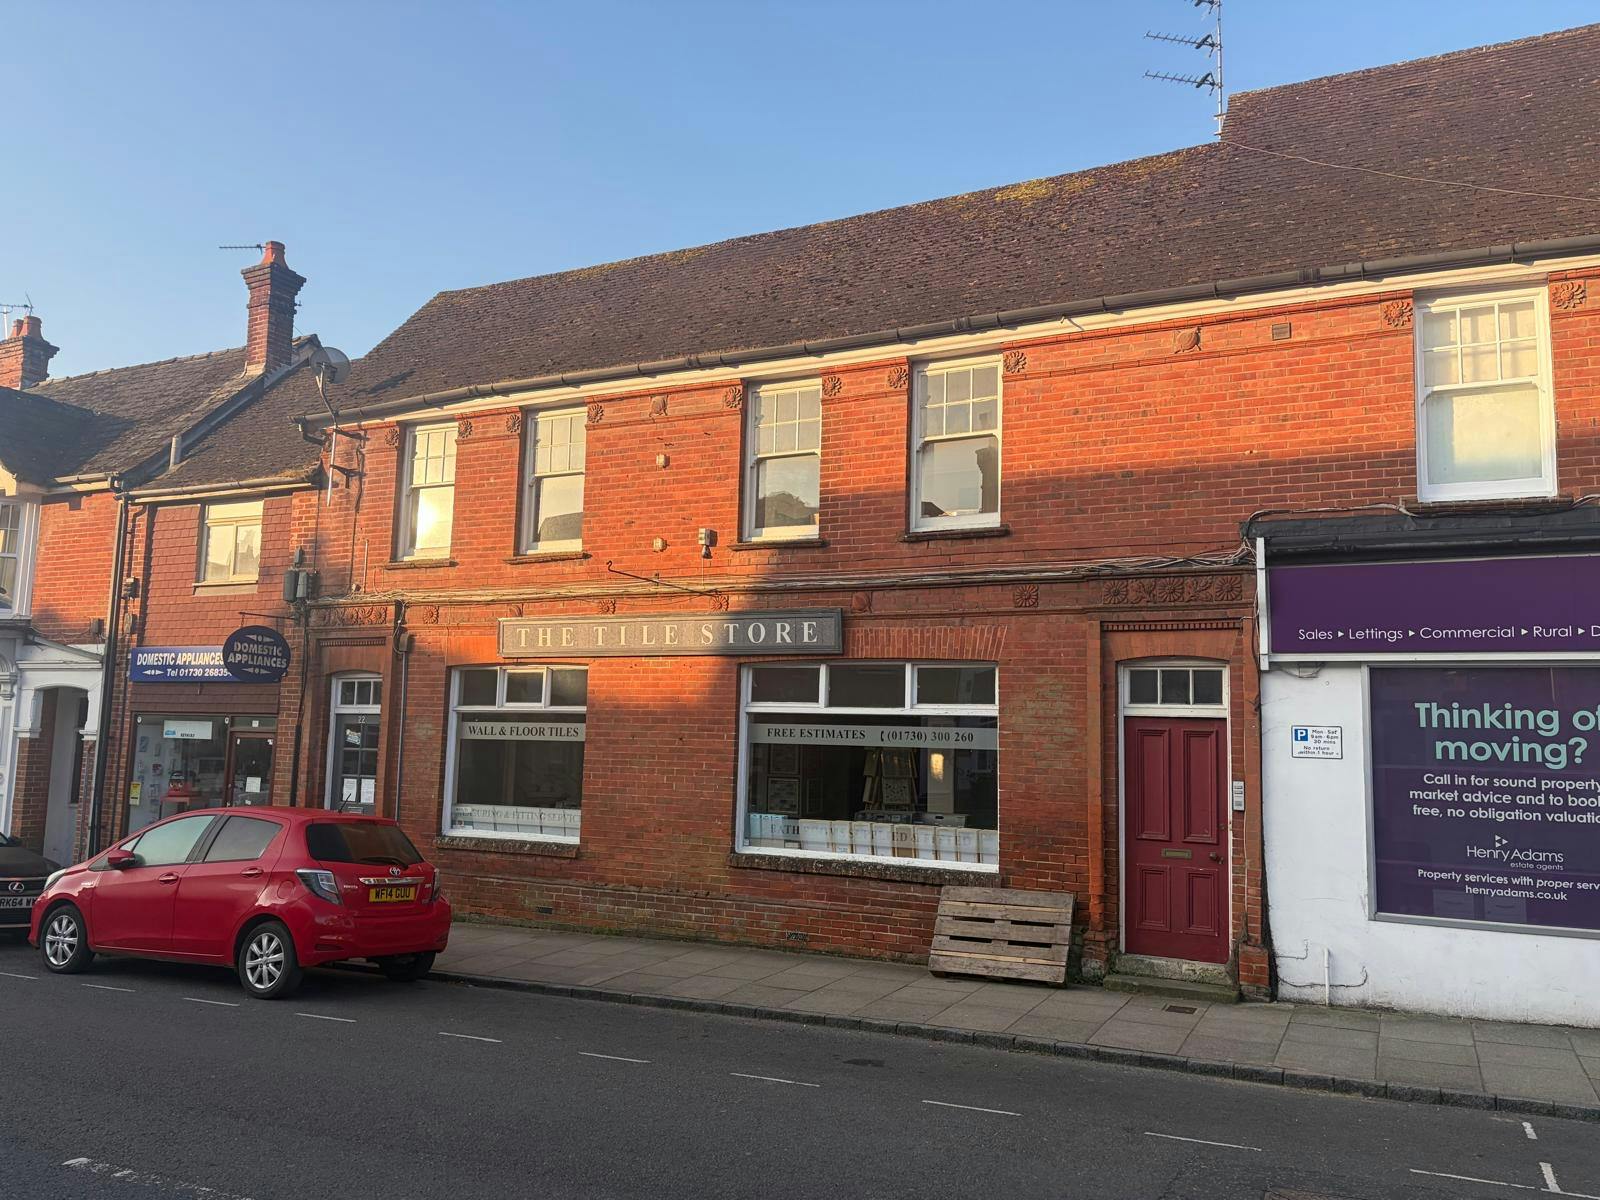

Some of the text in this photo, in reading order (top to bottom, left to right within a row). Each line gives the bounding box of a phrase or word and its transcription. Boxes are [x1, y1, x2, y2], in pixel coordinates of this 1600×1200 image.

[517, 621, 819, 648] THE TILE STORE
[1298, 629, 1333, 640] Sales
[1349, 628, 1403, 642] Lettings
[1419, 626, 1515, 639] Commercial
[1533, 625, 1572, 637] Rural
[234, 641, 283, 657] DOMESTIC
[137, 653, 175, 665] DOMESTIC
[227, 653, 287, 669] APPLIANCES
[166, 668, 178, 676] Tel
[179, 668, 203, 677] 01730
[1414, 702, 1560, 737] Thinking
[468, 725, 579, 738] WALL & FLOOR TILES
[767, 727, 974, 744] FREE ESTIMATES (01730) 300 260
[1297, 729, 1306, 741] P
[1435, 735, 1588, 770] moving?
[1423, 773, 1451, 785] Call
[1454, 774, 1468, 785] in
[1470, 775, 1490, 786] for
[1493, 777, 1537, 788] sound
[1409, 790, 1600, 807] market advice and to boo
[1413, 805, 1443, 818] free,
[1447, 808, 1465, 818] no
[1469, 808, 1542, 822] obligation
[1466, 846, 1564, 863] Henry Adams
[1417, 869, 1462, 882] Property
[1464, 873, 1509, 885] services
[1511, 875, 1534, 886] with
[1536, 877, 1574, 889] proper
[1465, 885, 1568, 901] henryadams.co.uk
